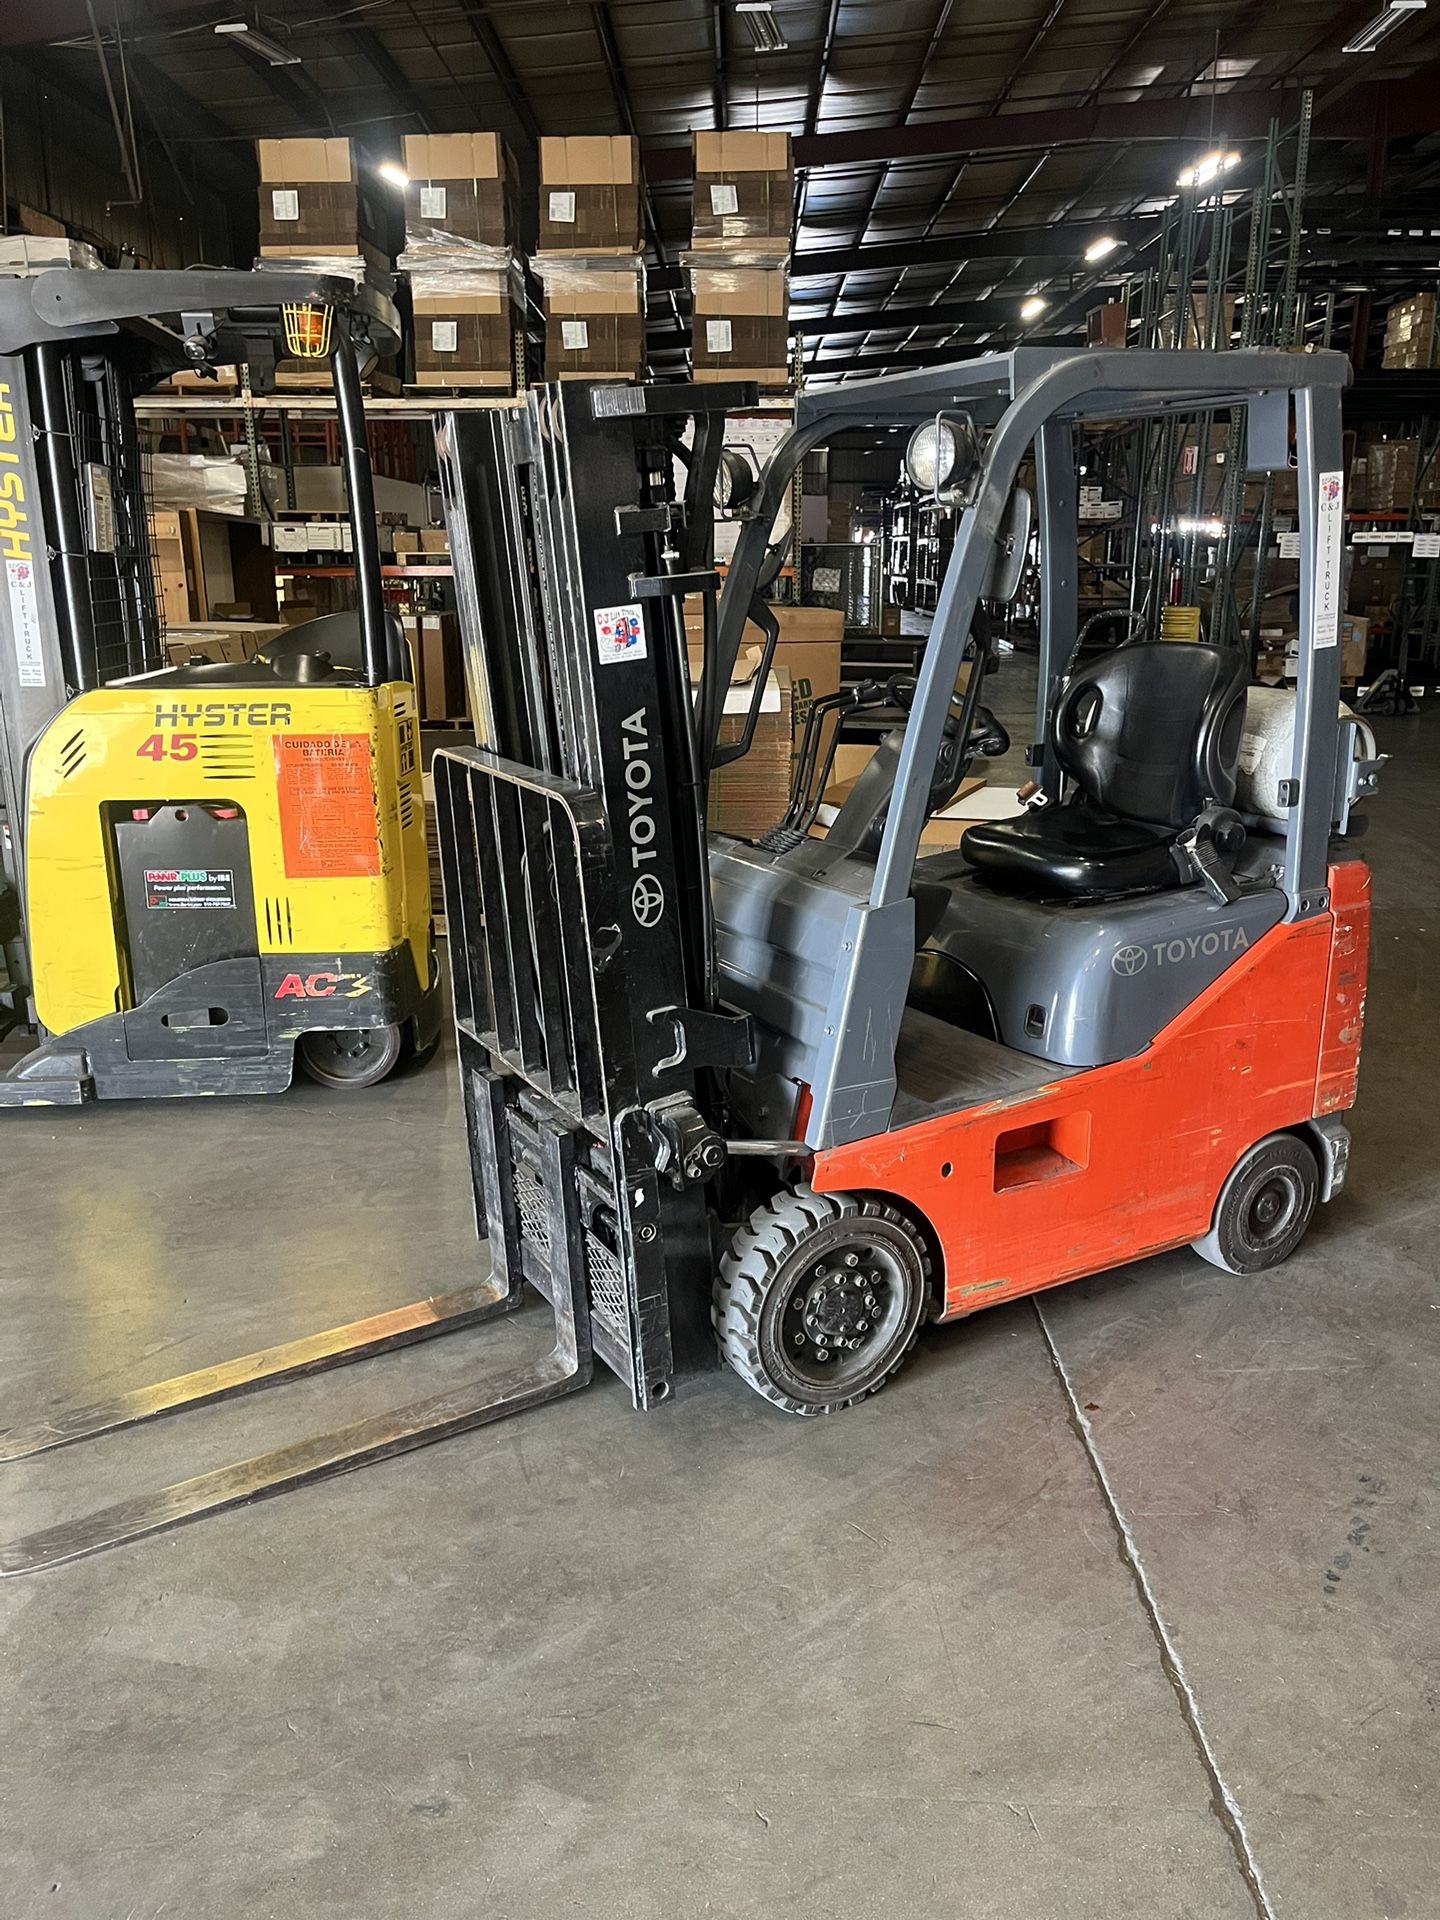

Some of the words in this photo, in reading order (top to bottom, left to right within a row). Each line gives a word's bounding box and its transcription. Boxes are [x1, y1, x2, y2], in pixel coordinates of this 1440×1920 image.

[1323, 560, 1331, 611] TRUCK
[23, 622, 33, 660] TRUCK
[155, 703, 291, 727] HYSTER
[136, 733, 198, 761] 45
[284, 740, 331, 749] CUIDADO
[303, 748, 345, 757] BATERIA
[621, 706, 657, 868] TOYOTA
[1153, 926, 1249, 966] TOYOTA
[274, 972, 338, 998] AC
